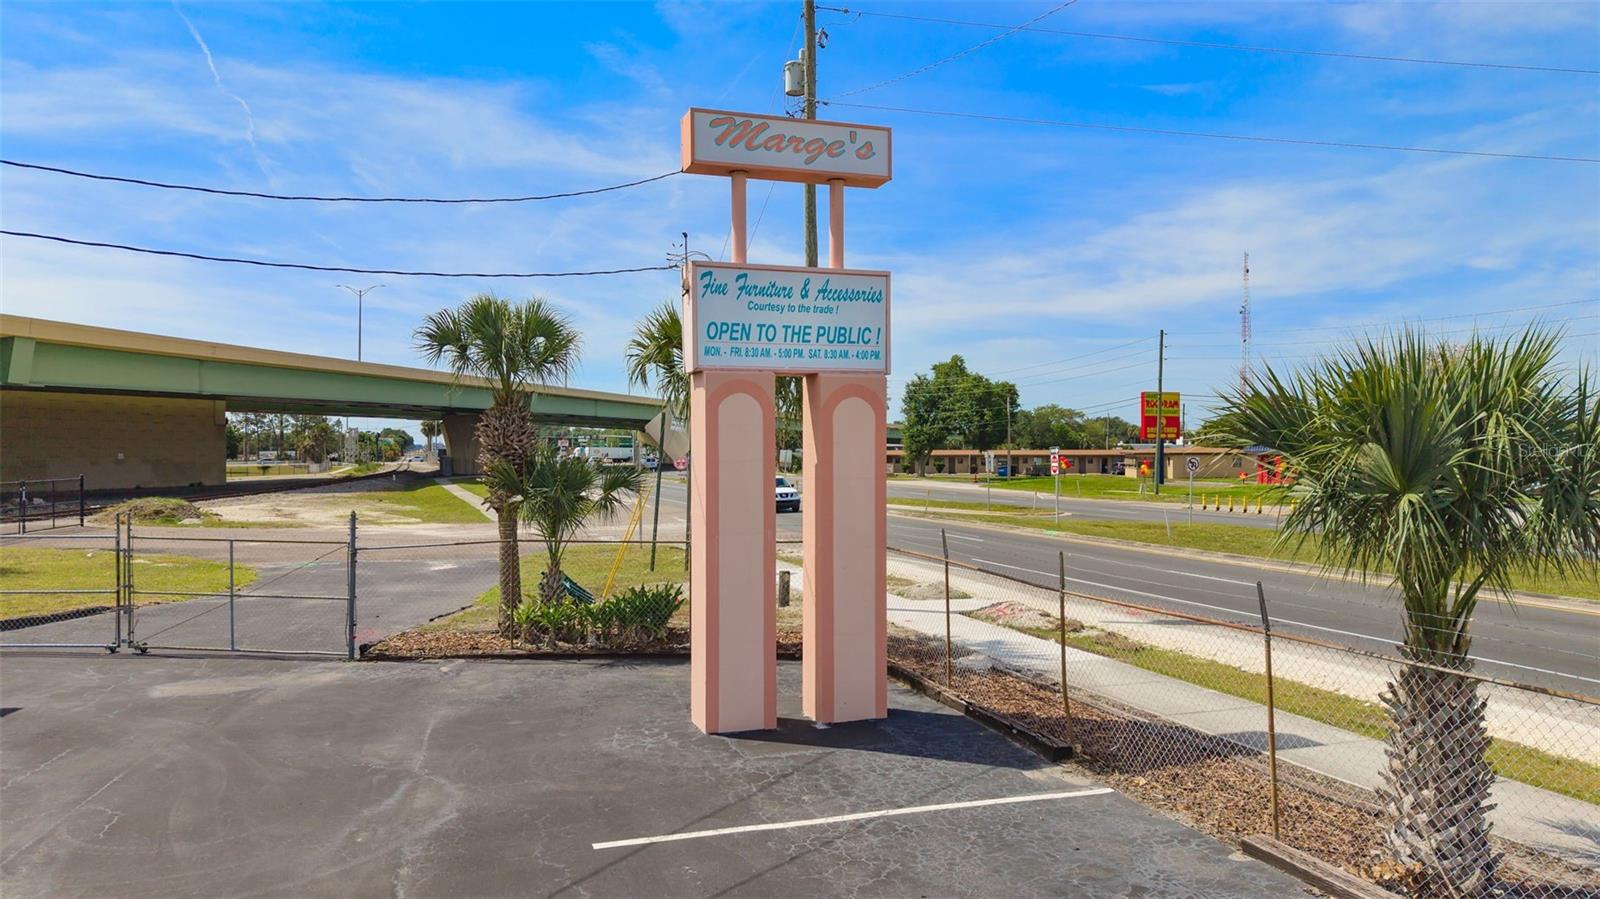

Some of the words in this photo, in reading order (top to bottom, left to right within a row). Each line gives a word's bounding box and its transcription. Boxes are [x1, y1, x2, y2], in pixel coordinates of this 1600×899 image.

[709, 116, 876, 165] Marge's
[700, 270, 729, 298] Fine
[735, 272, 794, 300] Furniture
[800, 277, 811, 300] &
[814, 278, 884, 303] Accessories
[747, 300, 785, 314] Courtesy
[787, 303, 796, 313] to
[797, 303, 811, 313] the
[813, 304, 834, 314] trade
[706, 321, 752, 341] OPEN
[756, 323, 777, 342] TO
[782, 325, 812, 343] THE
[816, 326, 872, 345] PUBLIC
[744, 347, 759, 357] 8:30
[778, 348, 793, 358] 5:00
